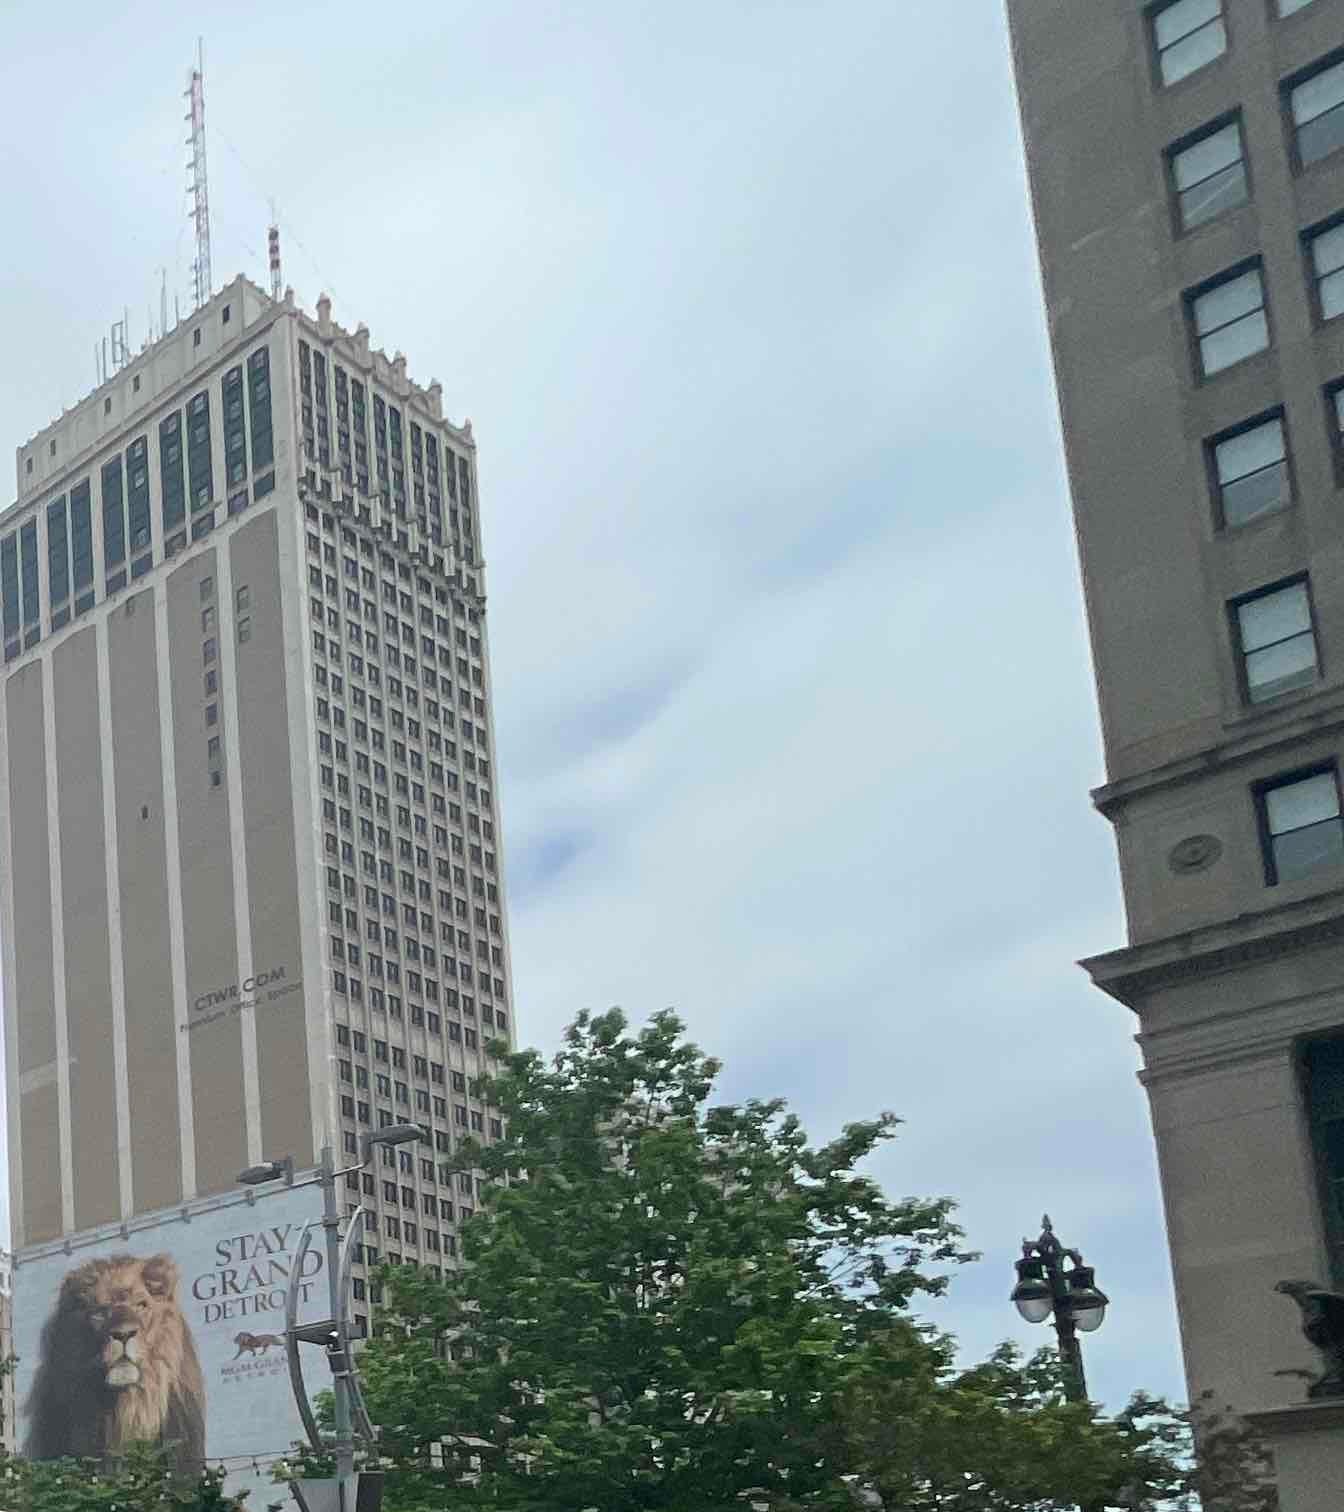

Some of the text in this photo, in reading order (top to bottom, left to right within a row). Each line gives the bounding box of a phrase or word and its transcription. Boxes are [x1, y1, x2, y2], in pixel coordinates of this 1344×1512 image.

[215, 1223, 292, 1267] STAY
[192, 1249, 323, 1301] GRAND
[204, 1282, 314, 1324] DETROT
